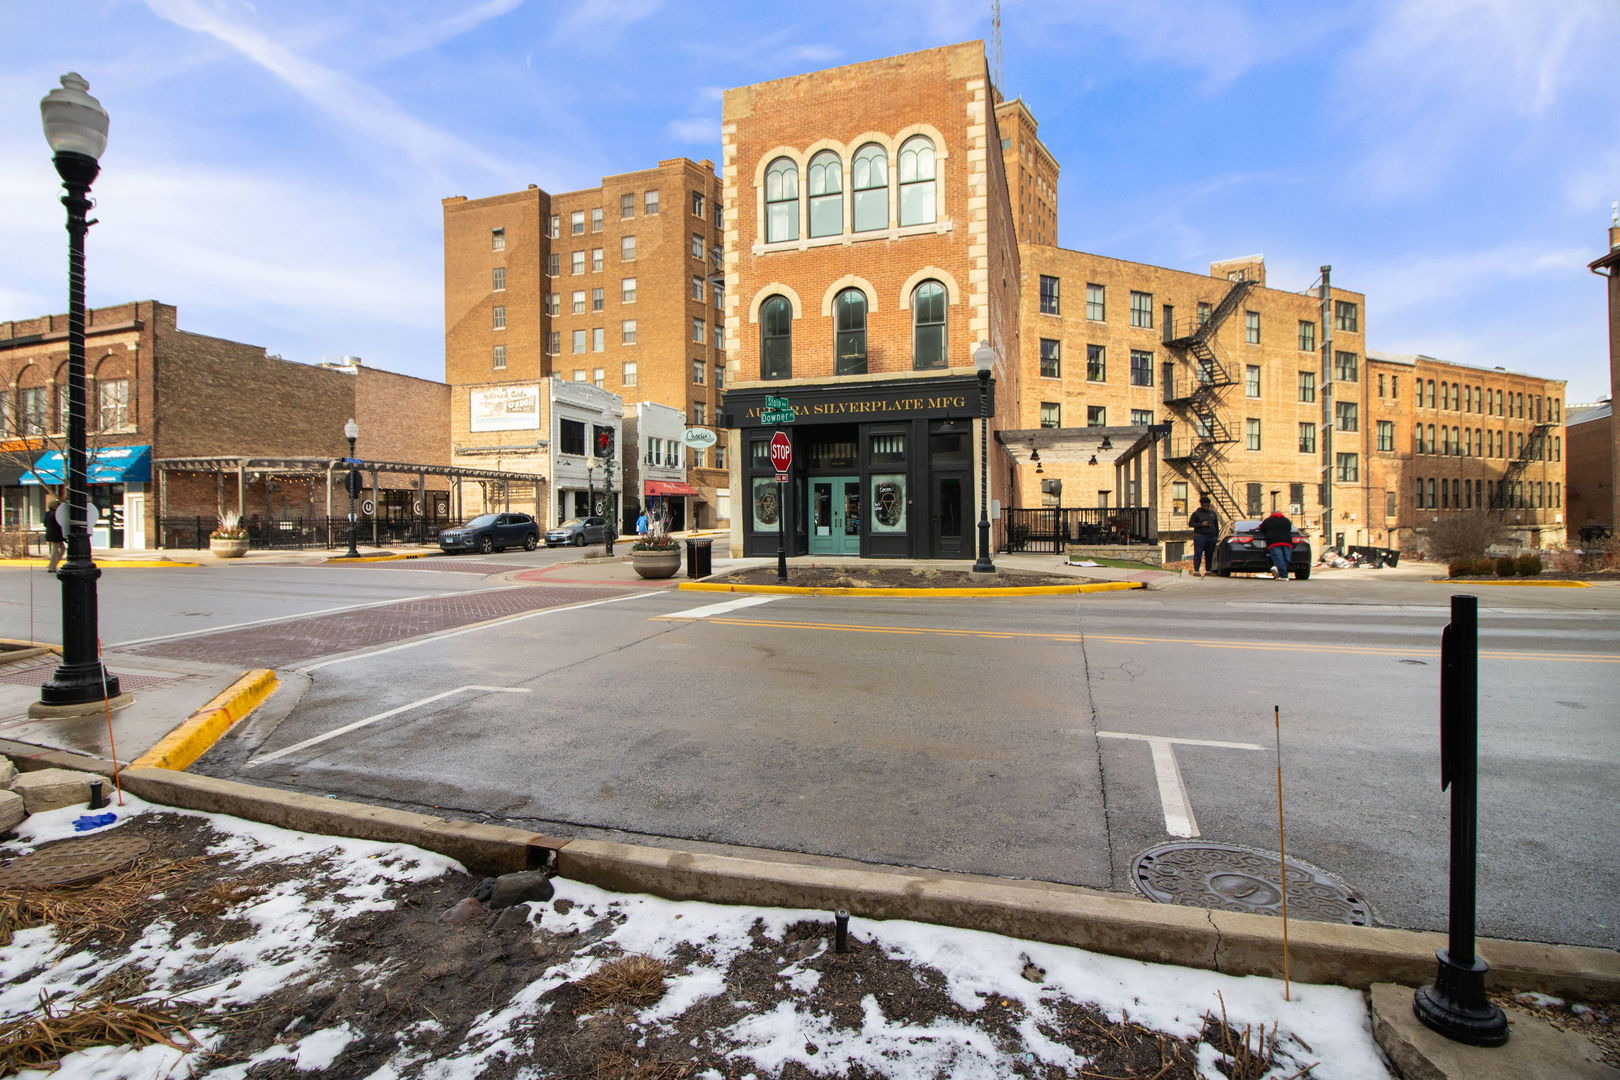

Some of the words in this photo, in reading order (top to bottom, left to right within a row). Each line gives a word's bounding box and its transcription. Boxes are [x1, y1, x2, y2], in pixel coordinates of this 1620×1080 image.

[745, 404, 810, 418] AURA
[813, 398, 924, 416] SILVERPLATE
[927, 396, 966, 409] MFG
[761, 412, 789, 423] Downer
[772, 444, 790, 460] STOP
